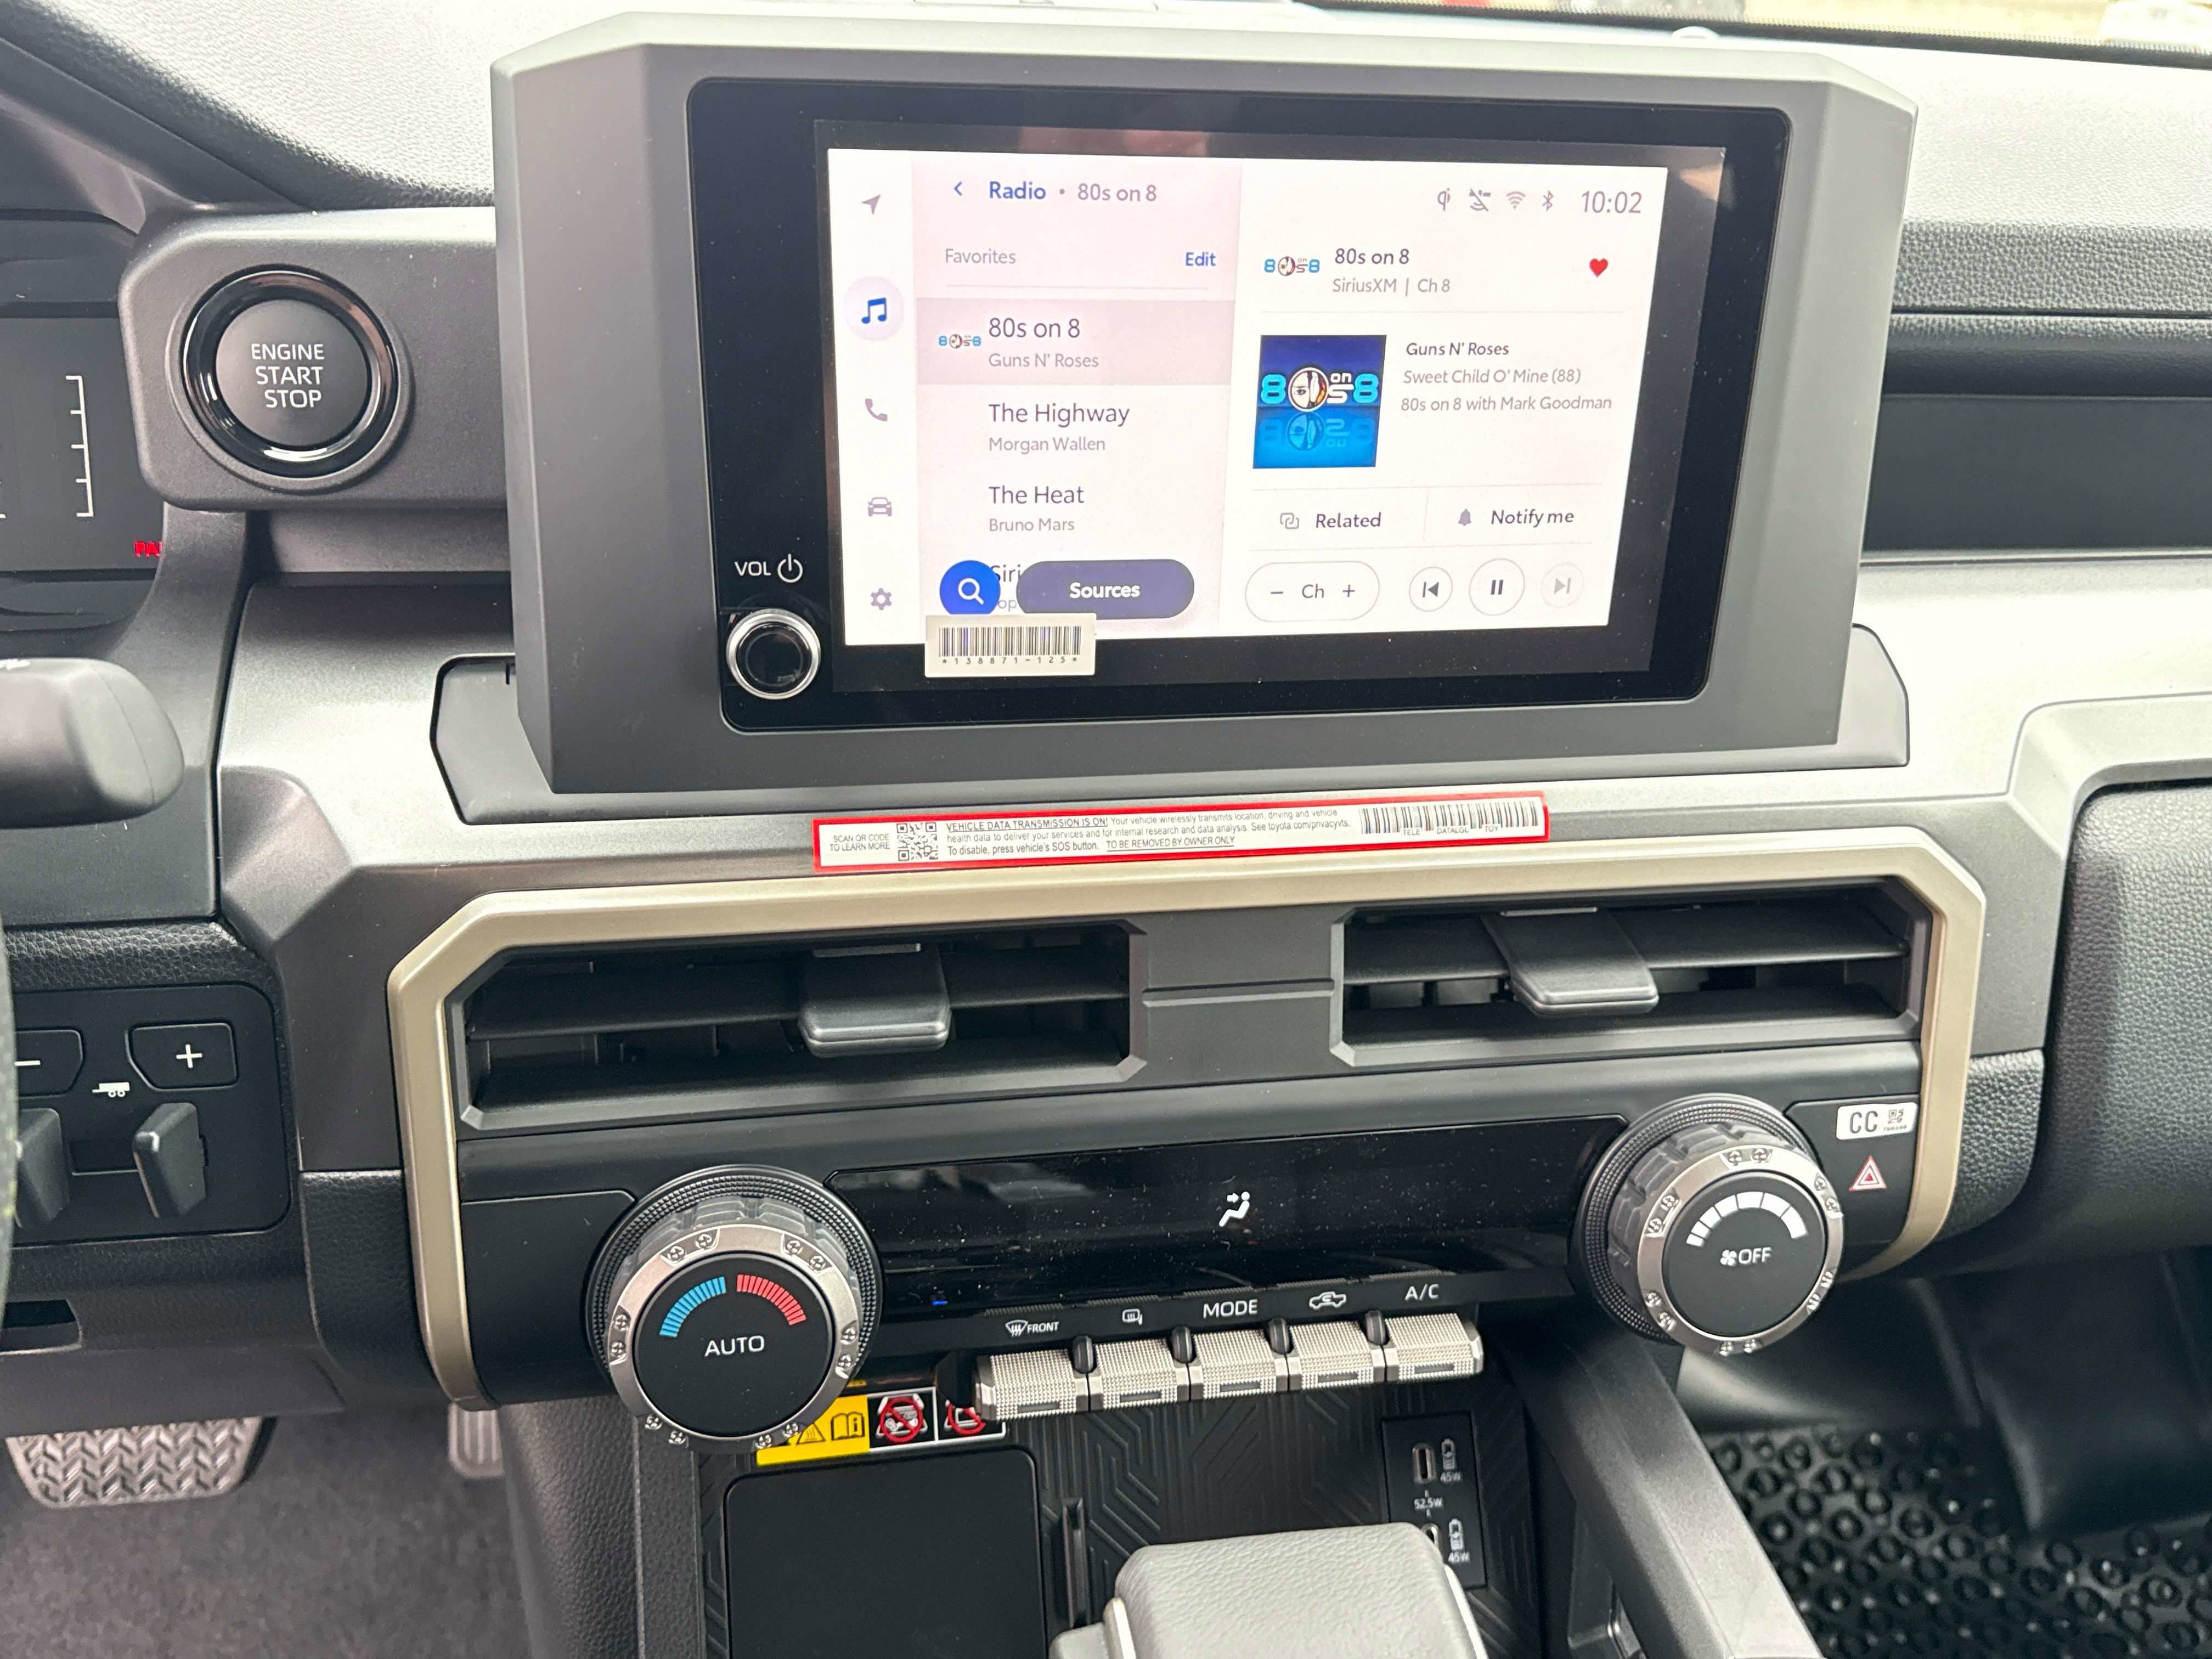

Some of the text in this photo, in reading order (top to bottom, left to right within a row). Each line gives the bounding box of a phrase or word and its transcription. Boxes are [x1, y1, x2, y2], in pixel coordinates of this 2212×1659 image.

[989, 181, 1158, 202] Radio 80s on 8
[1582, 190, 1642, 213] 10:02
[945, 249, 1017, 266] Favorites
[1185, 252, 1216, 267] Edit
[1334, 248, 1409, 264] 80s on 8
[1331, 278, 1397, 293] SiriusXM
[1417, 278, 1451, 293] Ch 8
[989, 318, 1080, 338] 80s on 8
[251, 343, 325, 360] ENGINE
[1406, 342, 1510, 356] Guns N' Roses
[989, 353, 1099, 369] Guns N' Roses
[256, 366, 324, 385] START
[1402, 368, 1582, 385] Sweet Child O' Mine (88)
[264, 390, 322, 409] STOP
[1400, 395, 1612, 411] 80s on 8 with Mark Goodman
[989, 403, 1130, 427] The Highway
[989, 437, 1105, 455] Morgan Wallen
[989, 485, 1085, 504] The Heat
[989, 518, 1075, 532] Bruno Mars
[1316, 512, 1382, 529] Related
[1491, 508, 1575, 528] Notify me
[734, 561, 771, 577] VOL
[1069, 582, 1141, 599] Sources
[1301, 583, 1325, 600] Ch
[946, 821, 985, 831] VEHICLE
[988, 820, 1011, 830] DATA
[1013, 817, 1080, 829] TRANSMISSION
[1082, 817, 1091, 826] IS
[1110, 817, 1128, 826] Your
[1130, 815, 1158, 824] vehicle
[1159, 814, 1197, 824] wirelessly
[1198, 812, 1233, 822] transmits
[1234, 811, 1267, 821] location,
[1268, 811, 1294, 820] driving
[1295, 809, 1310, 818] and
[1312, 809, 1338, 817] vehicle
[833, 834, 854, 843] SCAN
[868, 833, 890, 842] CODE
[947, 834, 971, 844] health
[973, 833, 991, 843] data
[994, 832, 1002, 842] to
[1004, 832, 1030, 841] deliver
[1032, 832, 1049, 843] your
[1051, 830, 1084, 840] services
[1086, 828, 1101, 838] and
[1102, 827, 1113, 838] for
[1115, 826, 1144, 837] internal
[1146, 825, 1180, 836] research
[1181, 824, 1195, 834] and
[1198, 824, 1215, 833] data
[1251, 822, 1267, 831] See
[830, 841, 890, 852] TO LEARN MORE
[947, 845, 958, 856] To
[960, 844, 991, 856] disable,
[992, 845, 1014, 856] press
[1016, 842, 1050, 853] vehicle's
[1052, 841, 1070, 852] SOS
[1106, 840, 1118, 849] TO
[1119, 839, 1130, 849] BE
[1131, 838, 1171, 848] REMOVED
[1172, 837, 1182, 847] BY
[1184, 836, 1214, 847] OWNER
[1215, 836, 1235, 845] ONLY
[1849, 1110, 1878, 1134] CC
[1739, 1246, 1773, 1264] OFF
[1404, 1283, 1439, 1302] A/C
[1203, 1298, 1259, 1318] MODE
[1026, 1321, 1060, 1334] FRONT
[704, 1335, 765, 1358] AUTO
[1440, 1471, 1462, 1483] 45W
[1413, 1497, 1443, 1510] 52.5W
[1448, 1551, 1470, 1564] 45W
